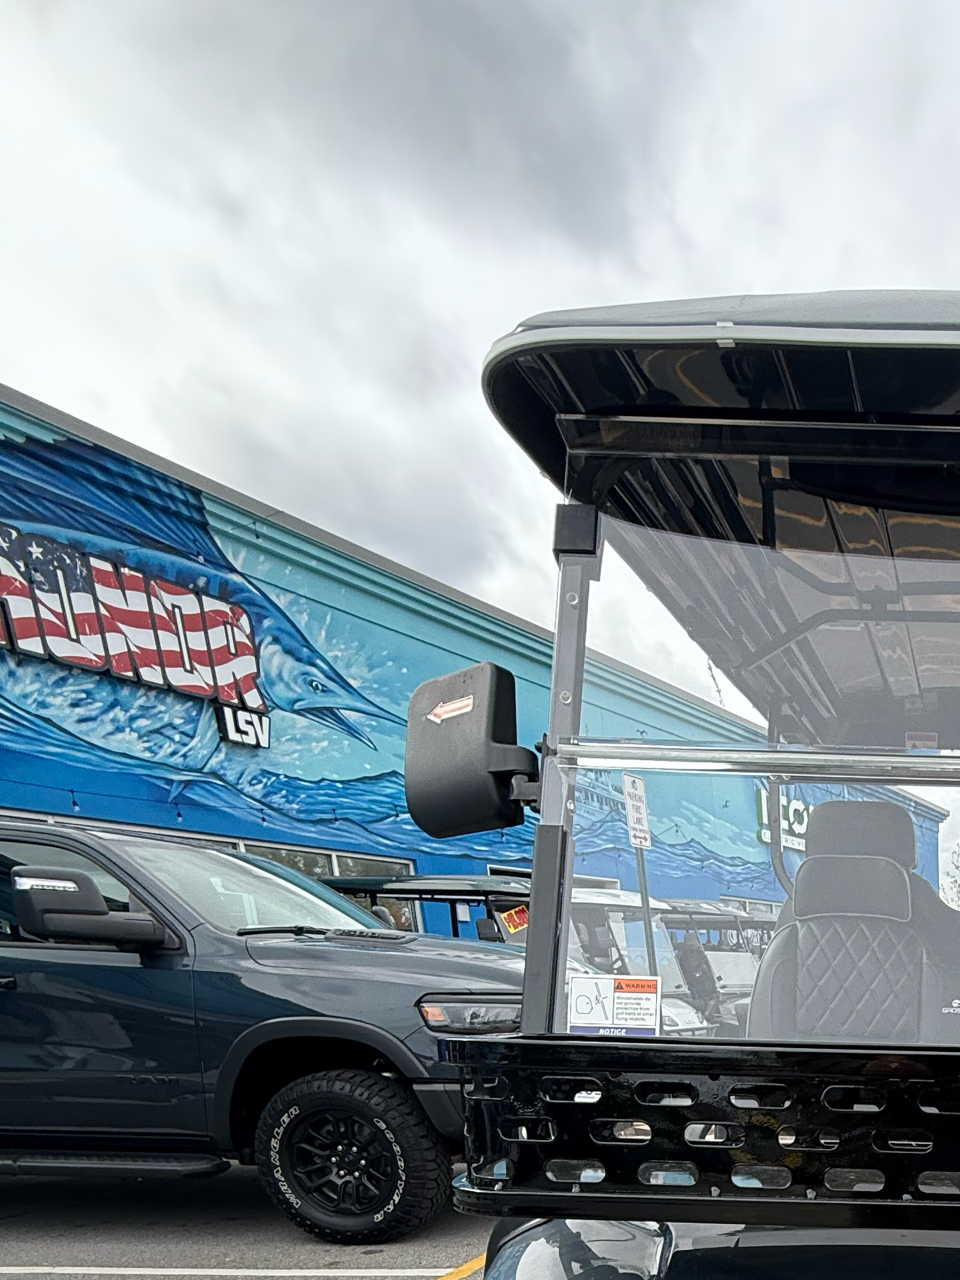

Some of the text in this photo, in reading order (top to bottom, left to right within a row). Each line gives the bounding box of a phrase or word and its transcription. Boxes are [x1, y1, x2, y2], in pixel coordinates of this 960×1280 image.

[224, 707, 269, 747] LSV
[270, 1105, 301, 1208] WRANGLER
[373, 1118, 406, 1222] GOODYEAR
